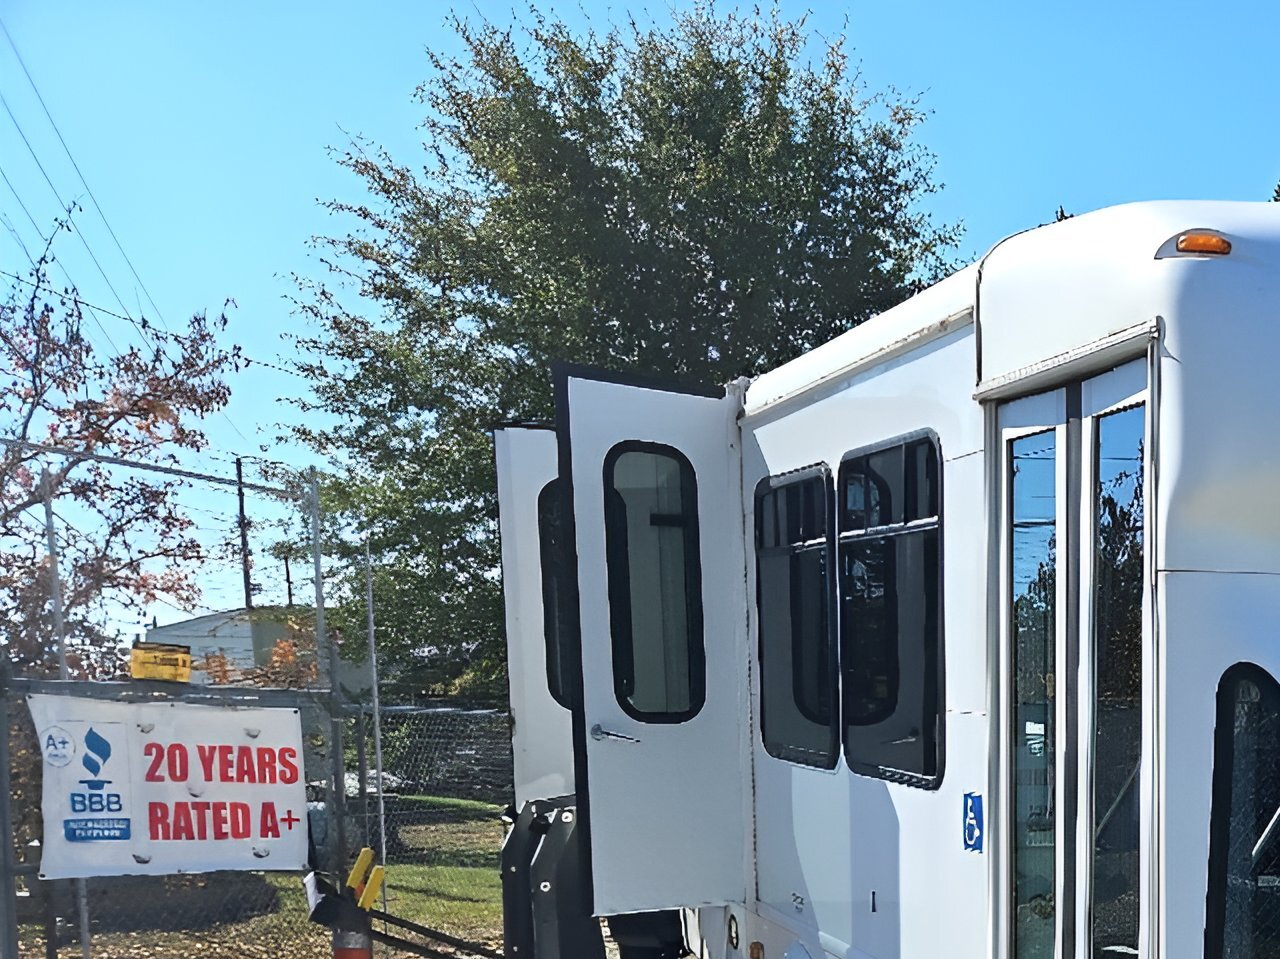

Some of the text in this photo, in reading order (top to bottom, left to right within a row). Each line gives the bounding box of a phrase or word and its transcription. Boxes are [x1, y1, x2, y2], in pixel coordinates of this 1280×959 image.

[46, 734, 69, 750] A+
[144, 743, 299, 784] 20 YEARS
[70, 793, 122, 813] BBB
[148, 801, 300, 841] RATED A+
